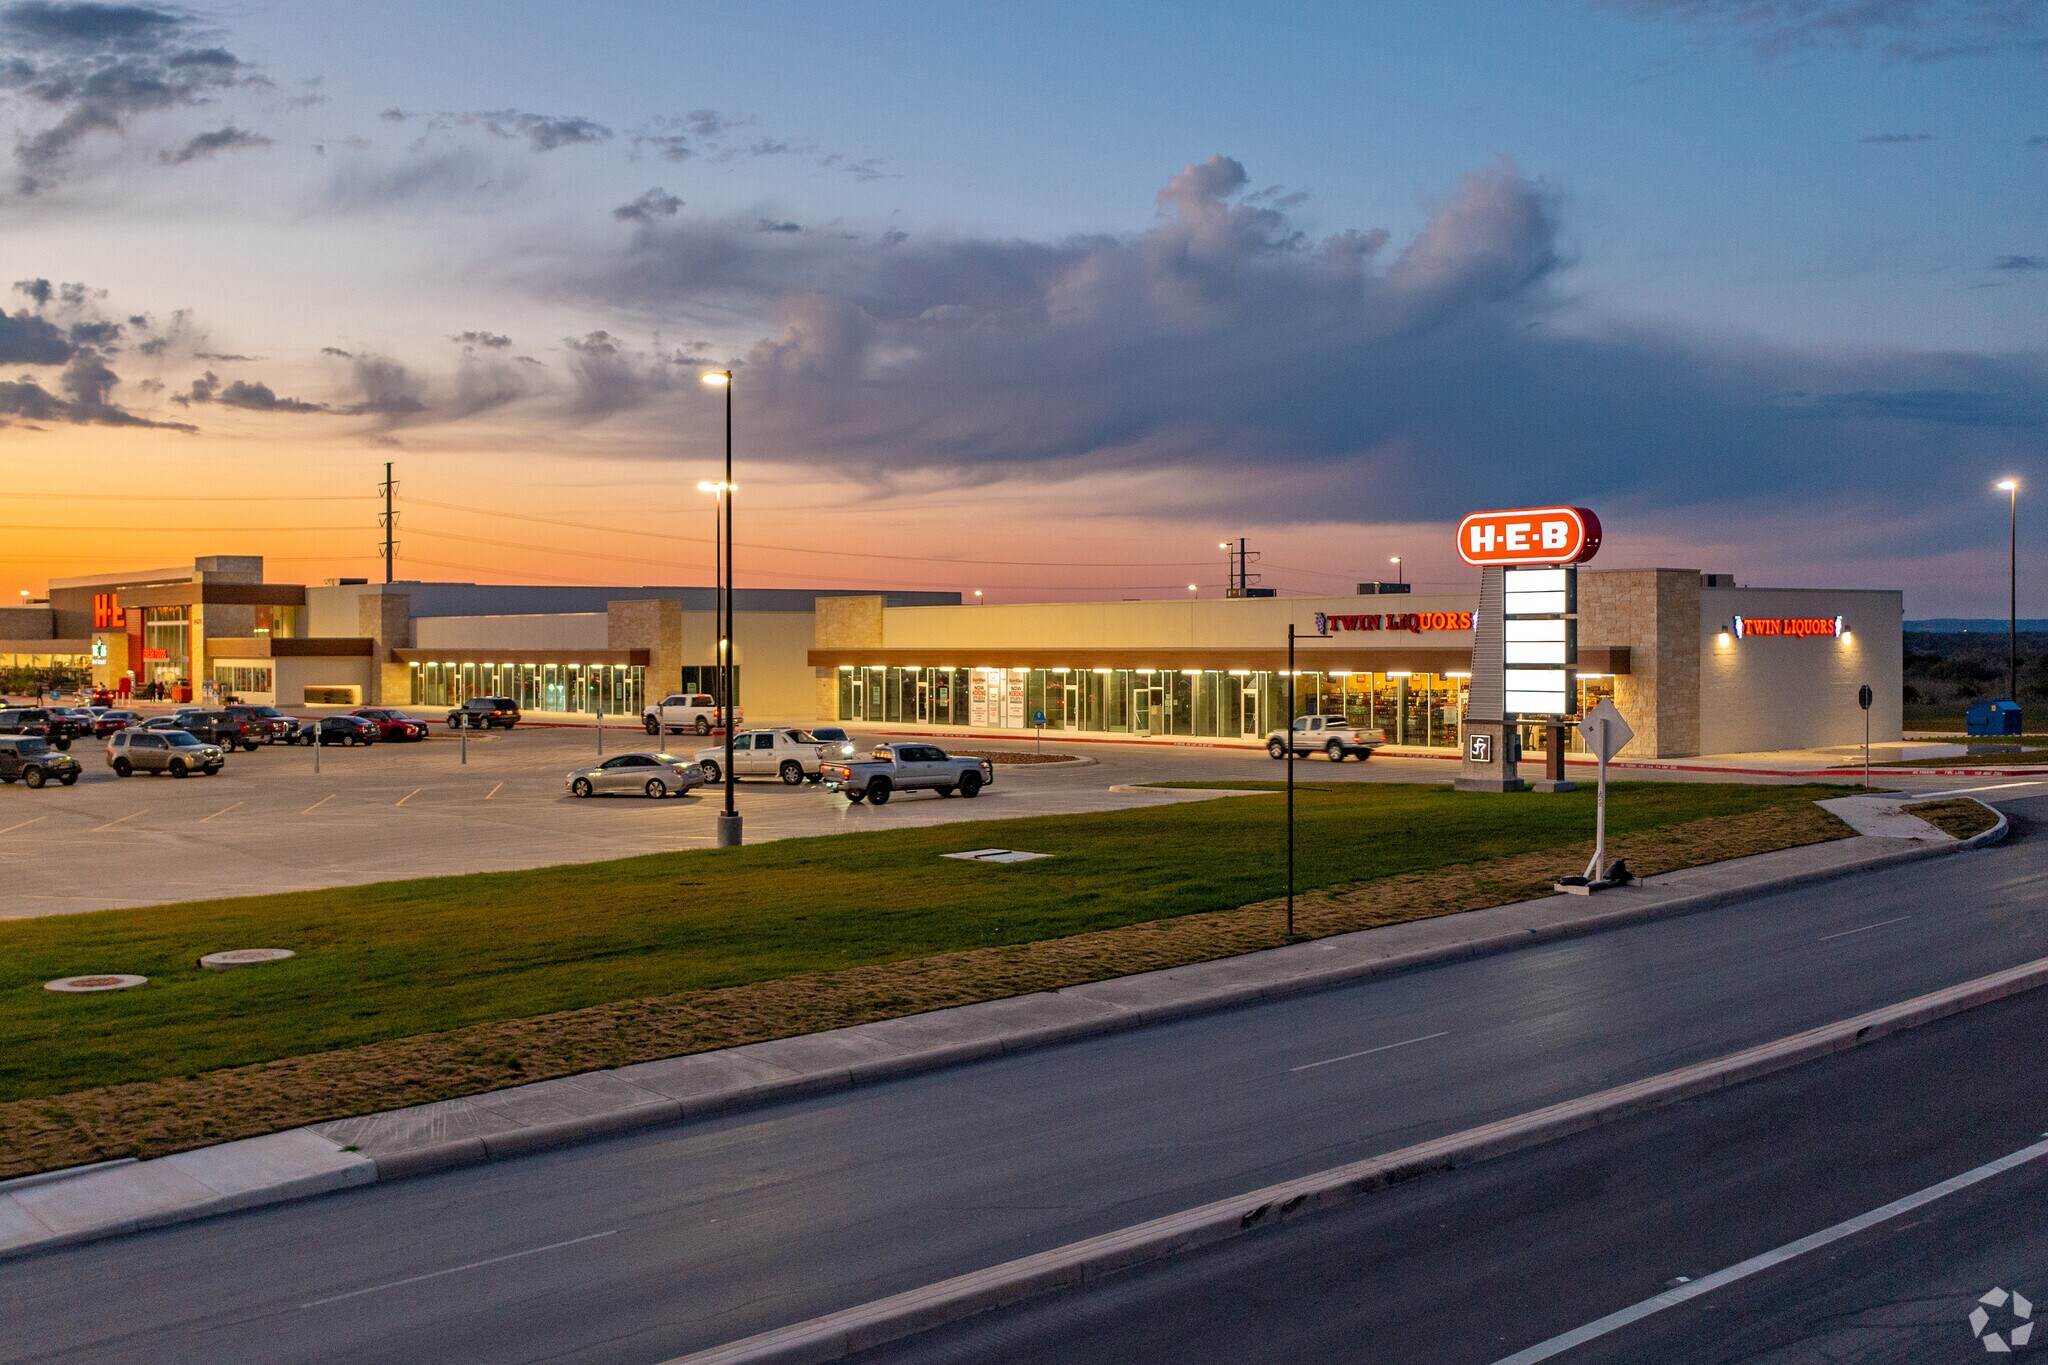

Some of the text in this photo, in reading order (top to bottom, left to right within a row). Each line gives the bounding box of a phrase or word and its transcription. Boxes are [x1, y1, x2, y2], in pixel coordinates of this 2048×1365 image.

[1470, 521, 1568, 553] H-E-B
[1327, 611, 1472, 634] TWIN LIQUORS
[1743, 618, 1834, 638] TWIN LIQUORS
